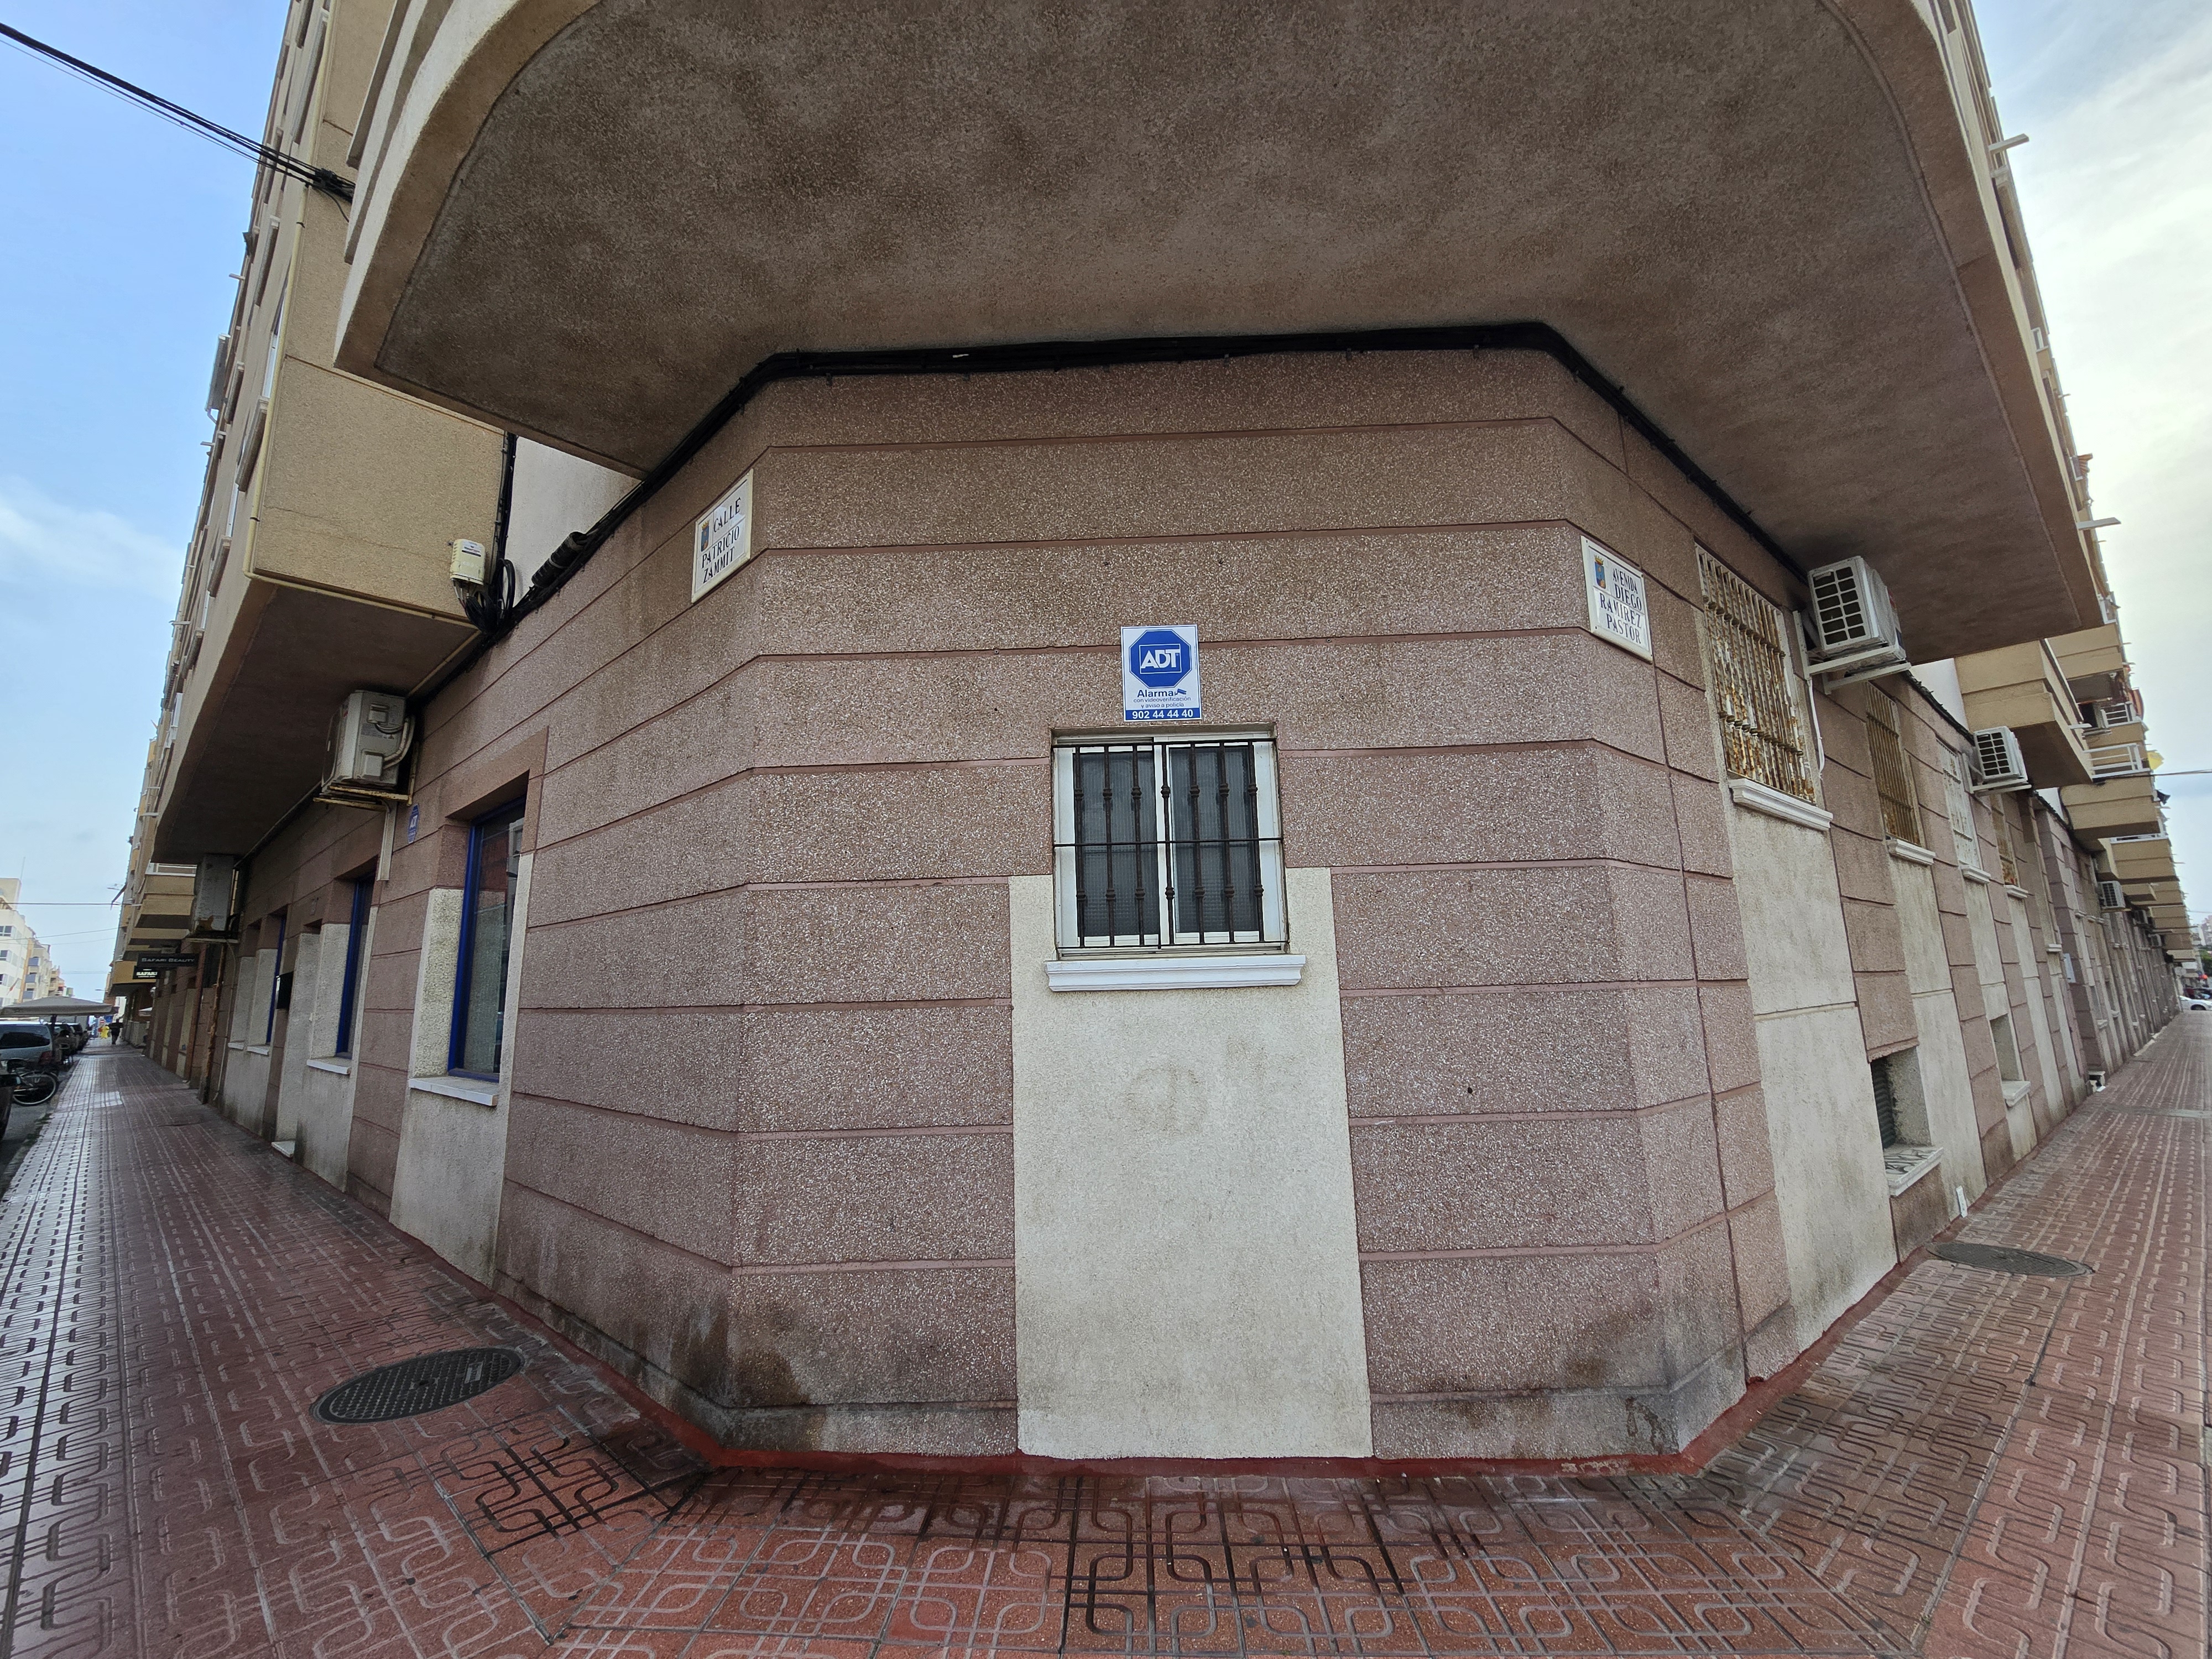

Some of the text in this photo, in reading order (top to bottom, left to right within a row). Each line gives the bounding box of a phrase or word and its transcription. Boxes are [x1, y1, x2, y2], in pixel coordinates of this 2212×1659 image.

[714, 497, 741, 533] CALLE
[701, 526, 740, 568] PATRICIO
[703, 546, 735, 584] ZAMMIT
[1613, 568, 1639, 594] AVENIDA
[1600, 592, 1642, 629] RAMIREZ
[1614, 583, 1642, 611] DIEGO
[1606, 613, 1641, 644] PASTOR
[1140, 649, 1180, 669] ADT
[1132, 709, 1193, 719] 902 44 44 40
